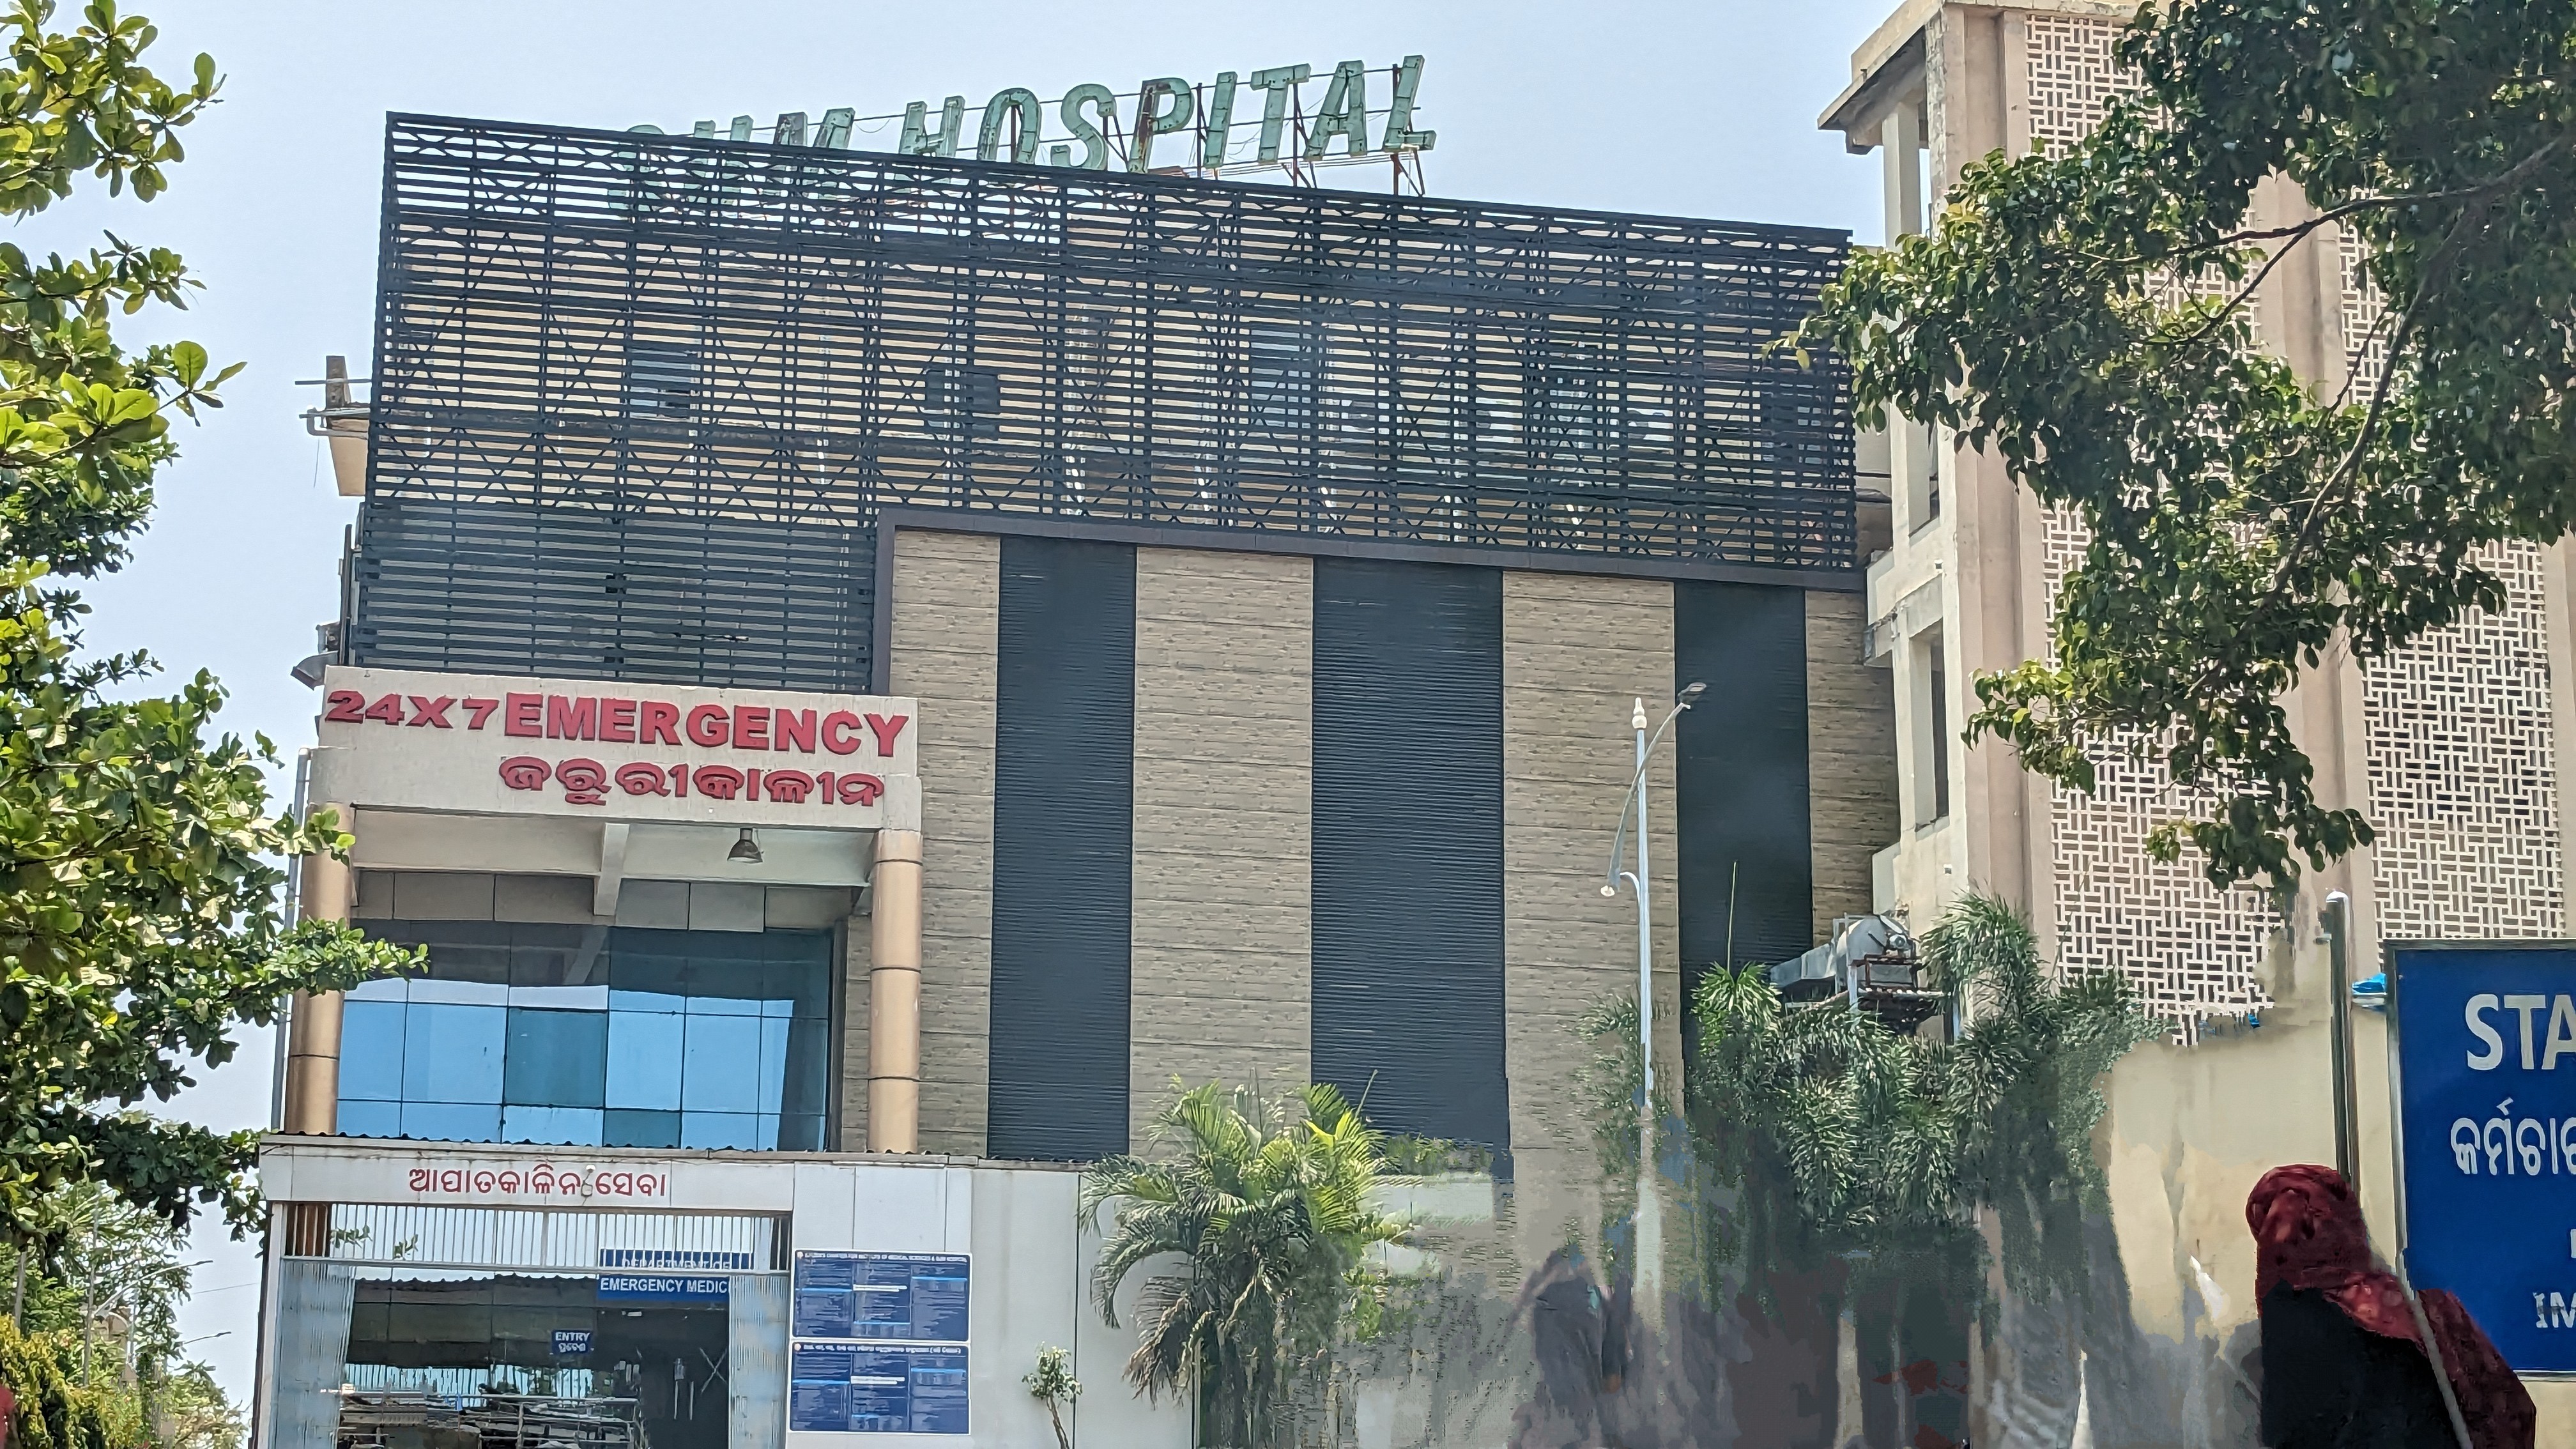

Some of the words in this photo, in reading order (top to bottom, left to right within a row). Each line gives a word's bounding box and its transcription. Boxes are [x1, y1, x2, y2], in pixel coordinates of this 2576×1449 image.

[898, 54, 1436, 174] HOSPITAL
[504, 692, 909, 758] EMERGENCY
[2465, 993, 2576, 1071] STA
[595, 1172, 666, 1197] ସେବା
[600, 1278, 684, 1293] EMERGENCY
[555, 1331, 590, 1342] ENTRY
